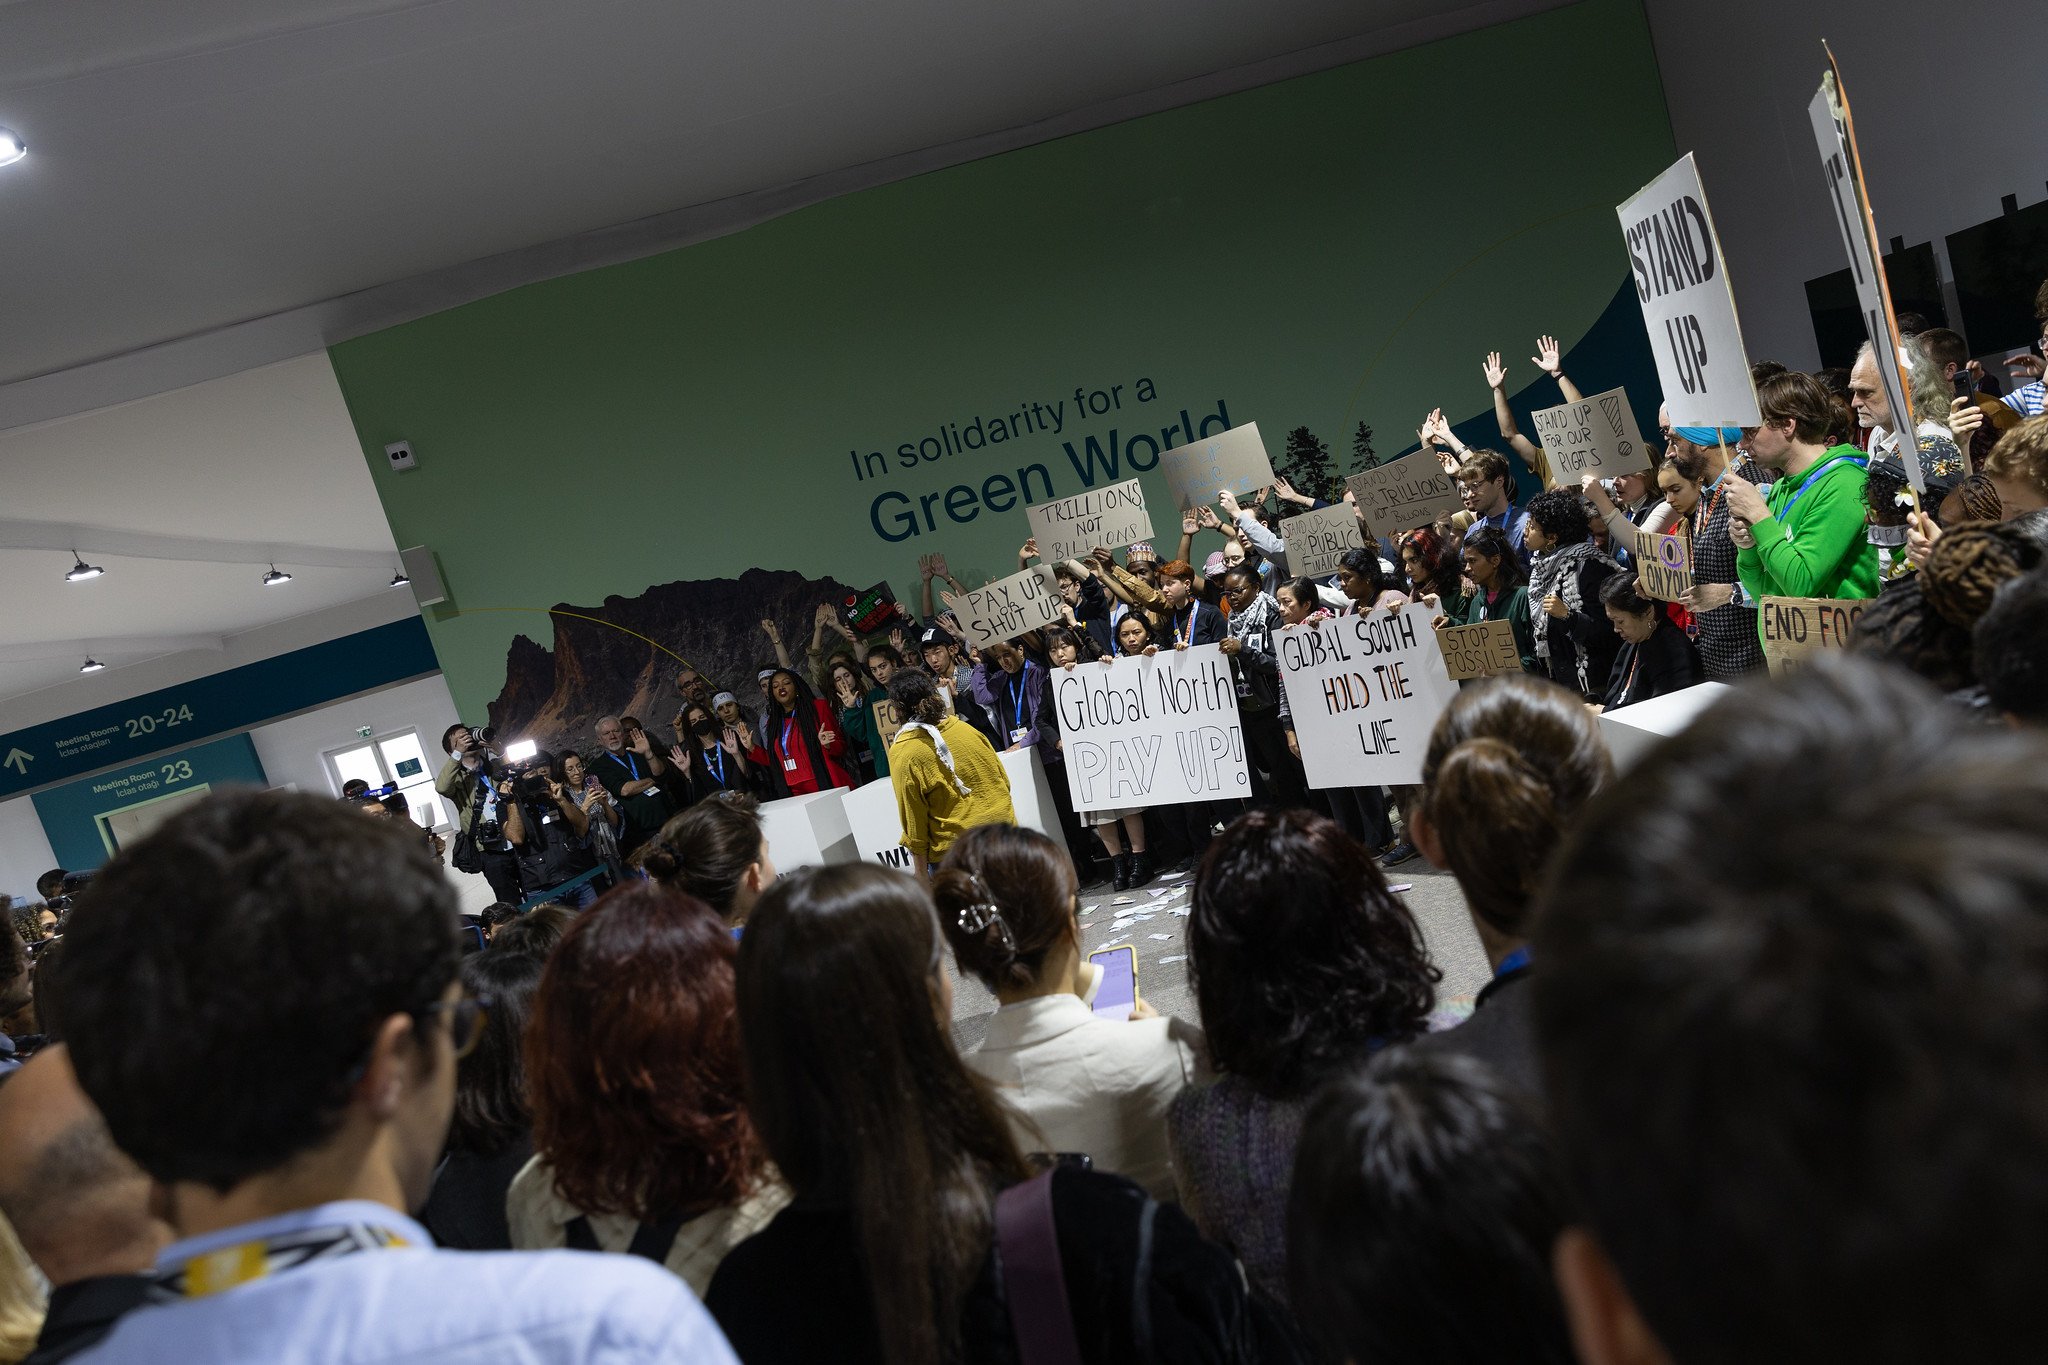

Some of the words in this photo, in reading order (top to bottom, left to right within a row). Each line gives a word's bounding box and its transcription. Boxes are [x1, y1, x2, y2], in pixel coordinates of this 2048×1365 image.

[1625, 195, 1715, 304] STAND
[1665, 314, 1708, 395] UP
[850, 449, 888, 481] In
[897, 401, 1065, 468] solidarity
[1073, 384, 1124, 419] for
[1136, 377, 1158, 402] a
[1534, 410, 1568, 432] STAND
[1573, 404, 1592, 426] UP
[1544, 433, 1565, 448] FOR
[1567, 427, 1592, 445] OUR
[870, 459, 1056, 543] Green
[1062, 399, 1233, 488] World
[1353, 471, 1387, 492] STAND
[1388, 464, 1408, 482] UP
[1557, 448, 1602, 474] RIGHTS
[1039, 482, 1143, 524] TRILLIONS
[1357, 492, 1379, 508] FOR
[1378, 474, 1449, 506] TRILLIONS
[1076, 516, 1103, 537] NOT
[1283, 520, 1306, 539] STAND
[1308, 514, 1324, 534] UP
[1374, 507, 1388, 521] NOT
[1288, 538, 1305, 552] FOR
[1308, 529, 1356, 554] PUBLIC
[1636, 532, 1658, 563] ALL
[967, 586, 1010, 616] PAY
[1019, 573, 1045, 601] UP
[1646, 563, 1665, 596] ON
[1664, 568, 1689, 599] YOU
[847, 609, 858, 619] NO
[971, 608, 1027, 641] SHUT
[1040, 594, 1063, 621] UP
[999, 600, 1019, 617] OR
[1764, 603, 1807, 643] END
[1282, 623, 1351, 673] GLOBAL
[1355, 613, 1417, 656] SOUTH
[1446, 627, 1489, 651] STOP
[1497, 626, 1519, 669] FUEL
[1445, 649, 1504, 675] FOSSIL
[1059, 669, 1149, 732] Global
[1157, 661, 1234, 715] North
[1322, 672, 1370, 716] HOLD
[1373, 661, 1413, 701] THE
[55, 731, 91, 749] Meeting
[90, 724, 120, 739] Rooms
[125, 704, 194, 739] 20-24
[1357, 718, 1400, 755] LINE
[161, 759, 194, 785] 23
[1073, 735, 1162, 803] PAY
[1175, 725, 1246, 796] UP!
[92, 778, 130, 794] Meeting
[129, 770, 156, 784] Room
